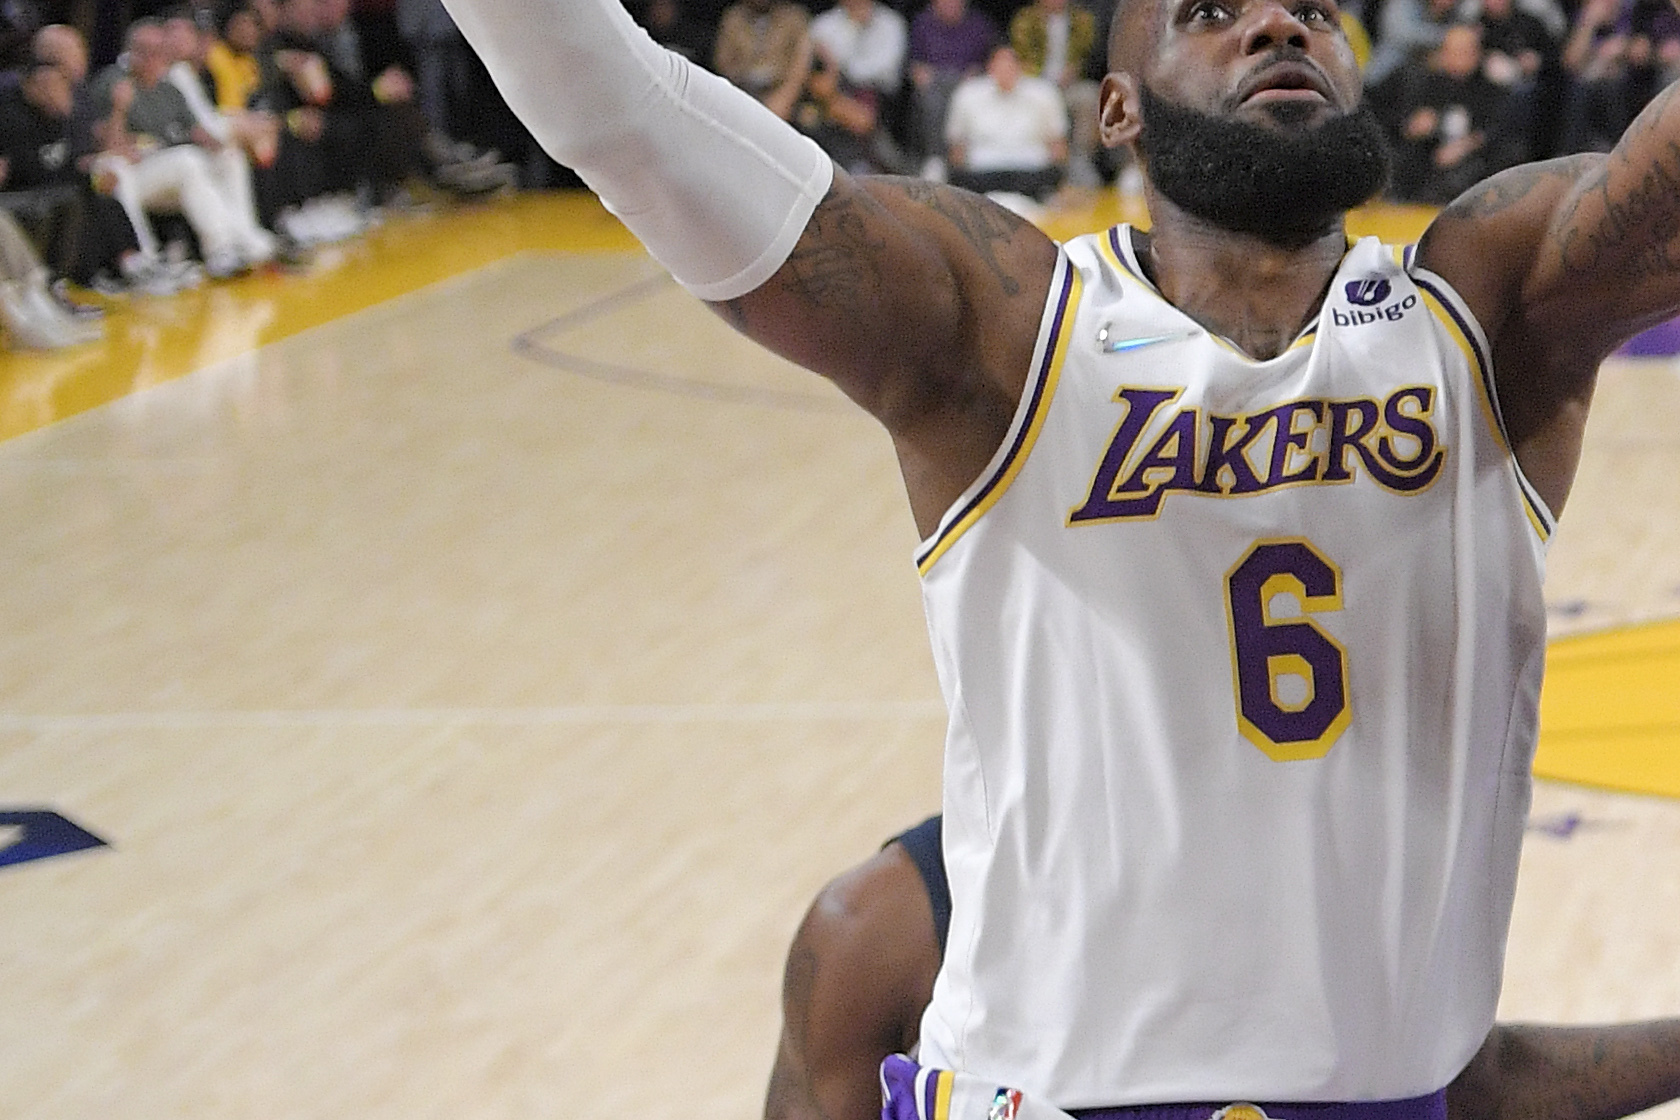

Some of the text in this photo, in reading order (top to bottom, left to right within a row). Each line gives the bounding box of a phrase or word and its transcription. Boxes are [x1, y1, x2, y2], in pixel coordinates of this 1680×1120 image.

[1332, 294, 1417, 327] bibigo
[1065, 383, 1449, 529] LAKERS
[1223, 535, 1353, 762] 6
